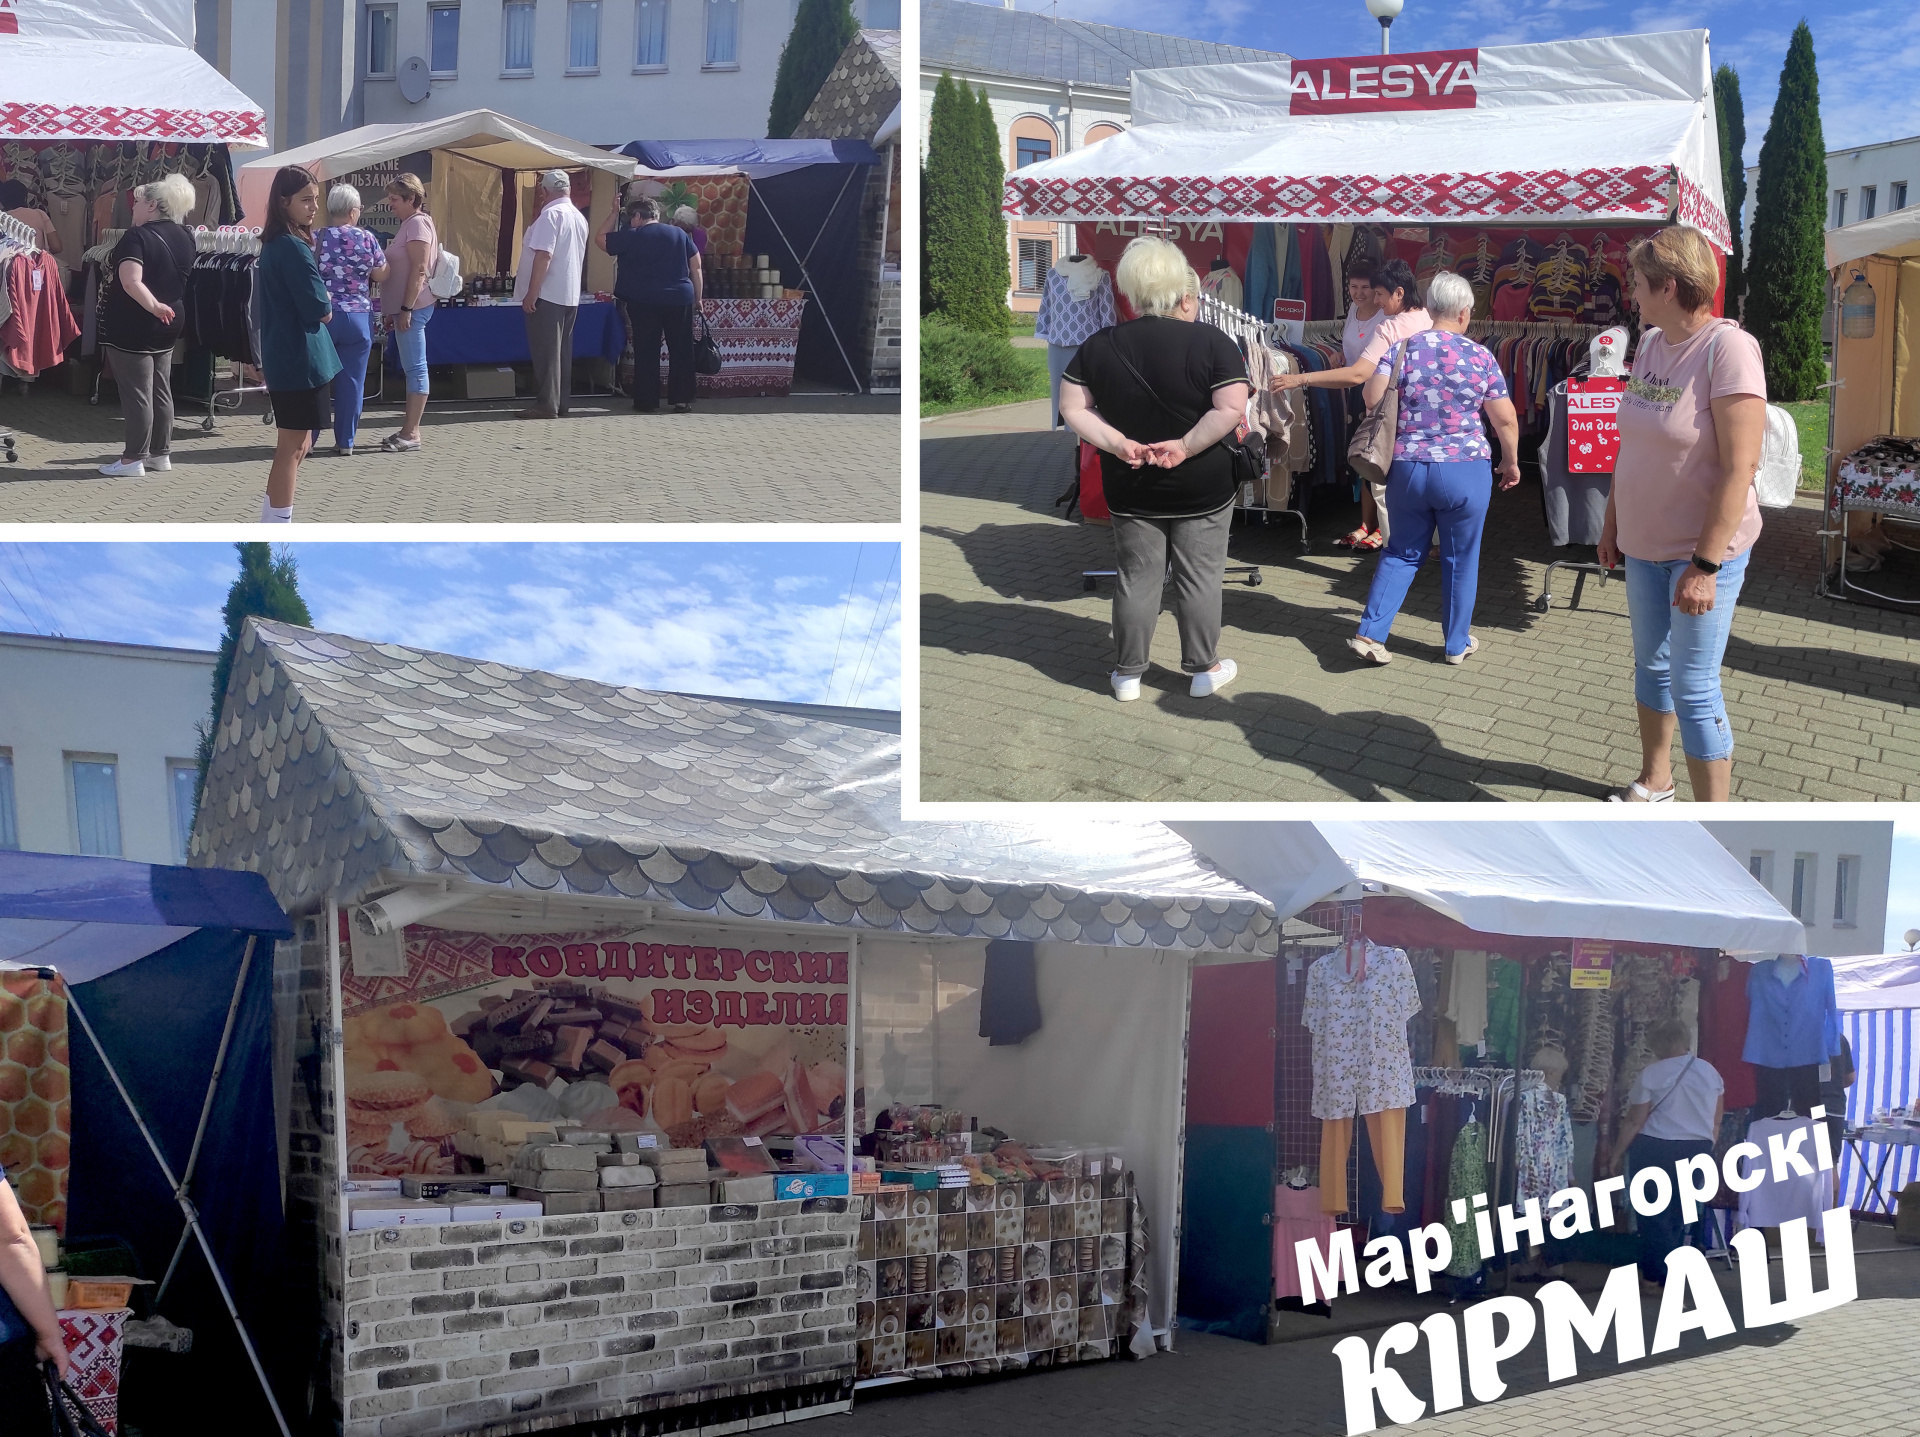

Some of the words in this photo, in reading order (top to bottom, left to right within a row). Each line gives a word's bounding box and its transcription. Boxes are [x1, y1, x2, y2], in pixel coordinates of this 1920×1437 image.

[1290, 59, 1478, 101] ALESYA
[1276, 306, 1304, 314] СКИДКИ
[1568, 397, 1621, 409] ALES
[1571, 419, 1593, 432] для
[491, 942, 849, 984] КОНДИТЕРСКИЕ
[651, 988, 848, 1028] ИЗДЕЛИЯ
